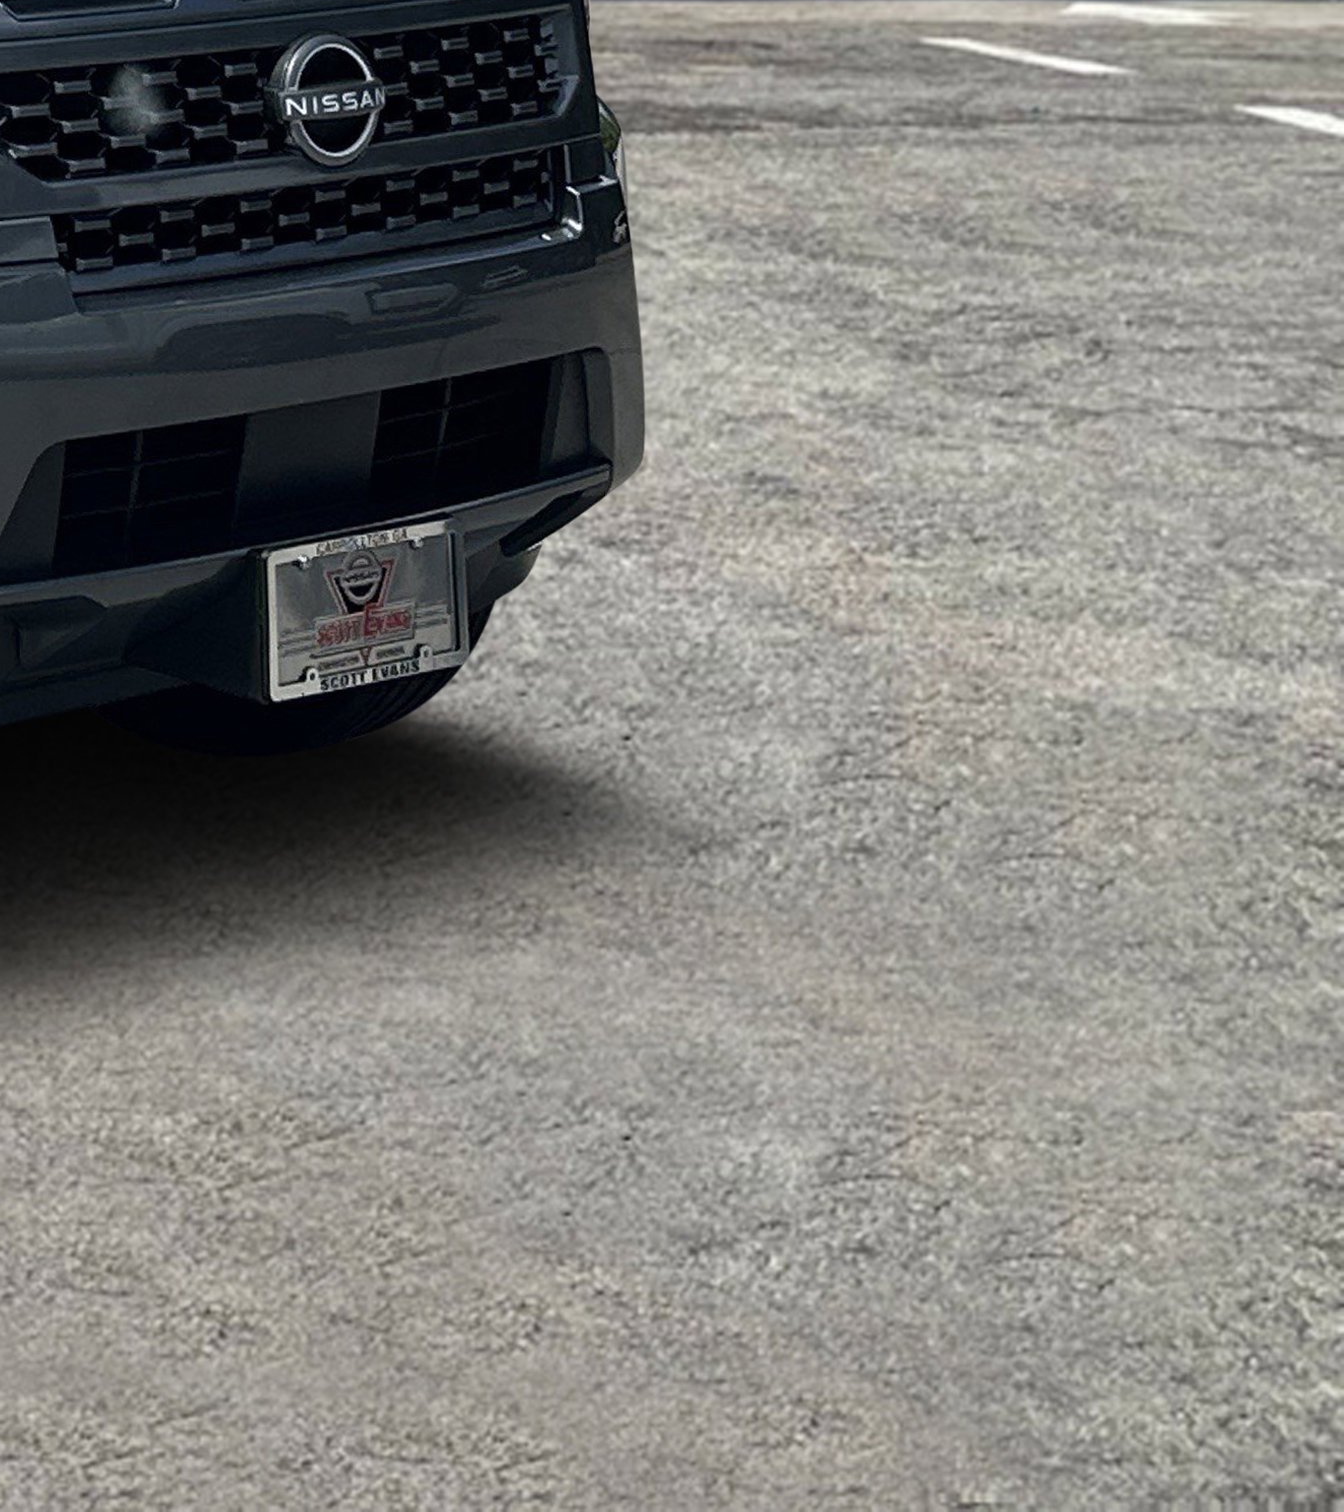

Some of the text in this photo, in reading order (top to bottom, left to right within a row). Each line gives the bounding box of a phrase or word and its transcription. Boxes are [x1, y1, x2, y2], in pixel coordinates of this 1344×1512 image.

[284, 87, 386, 116] NISSAN
[320, 671, 367, 691] SCOTT
[372, 660, 421, 681] EVANS
